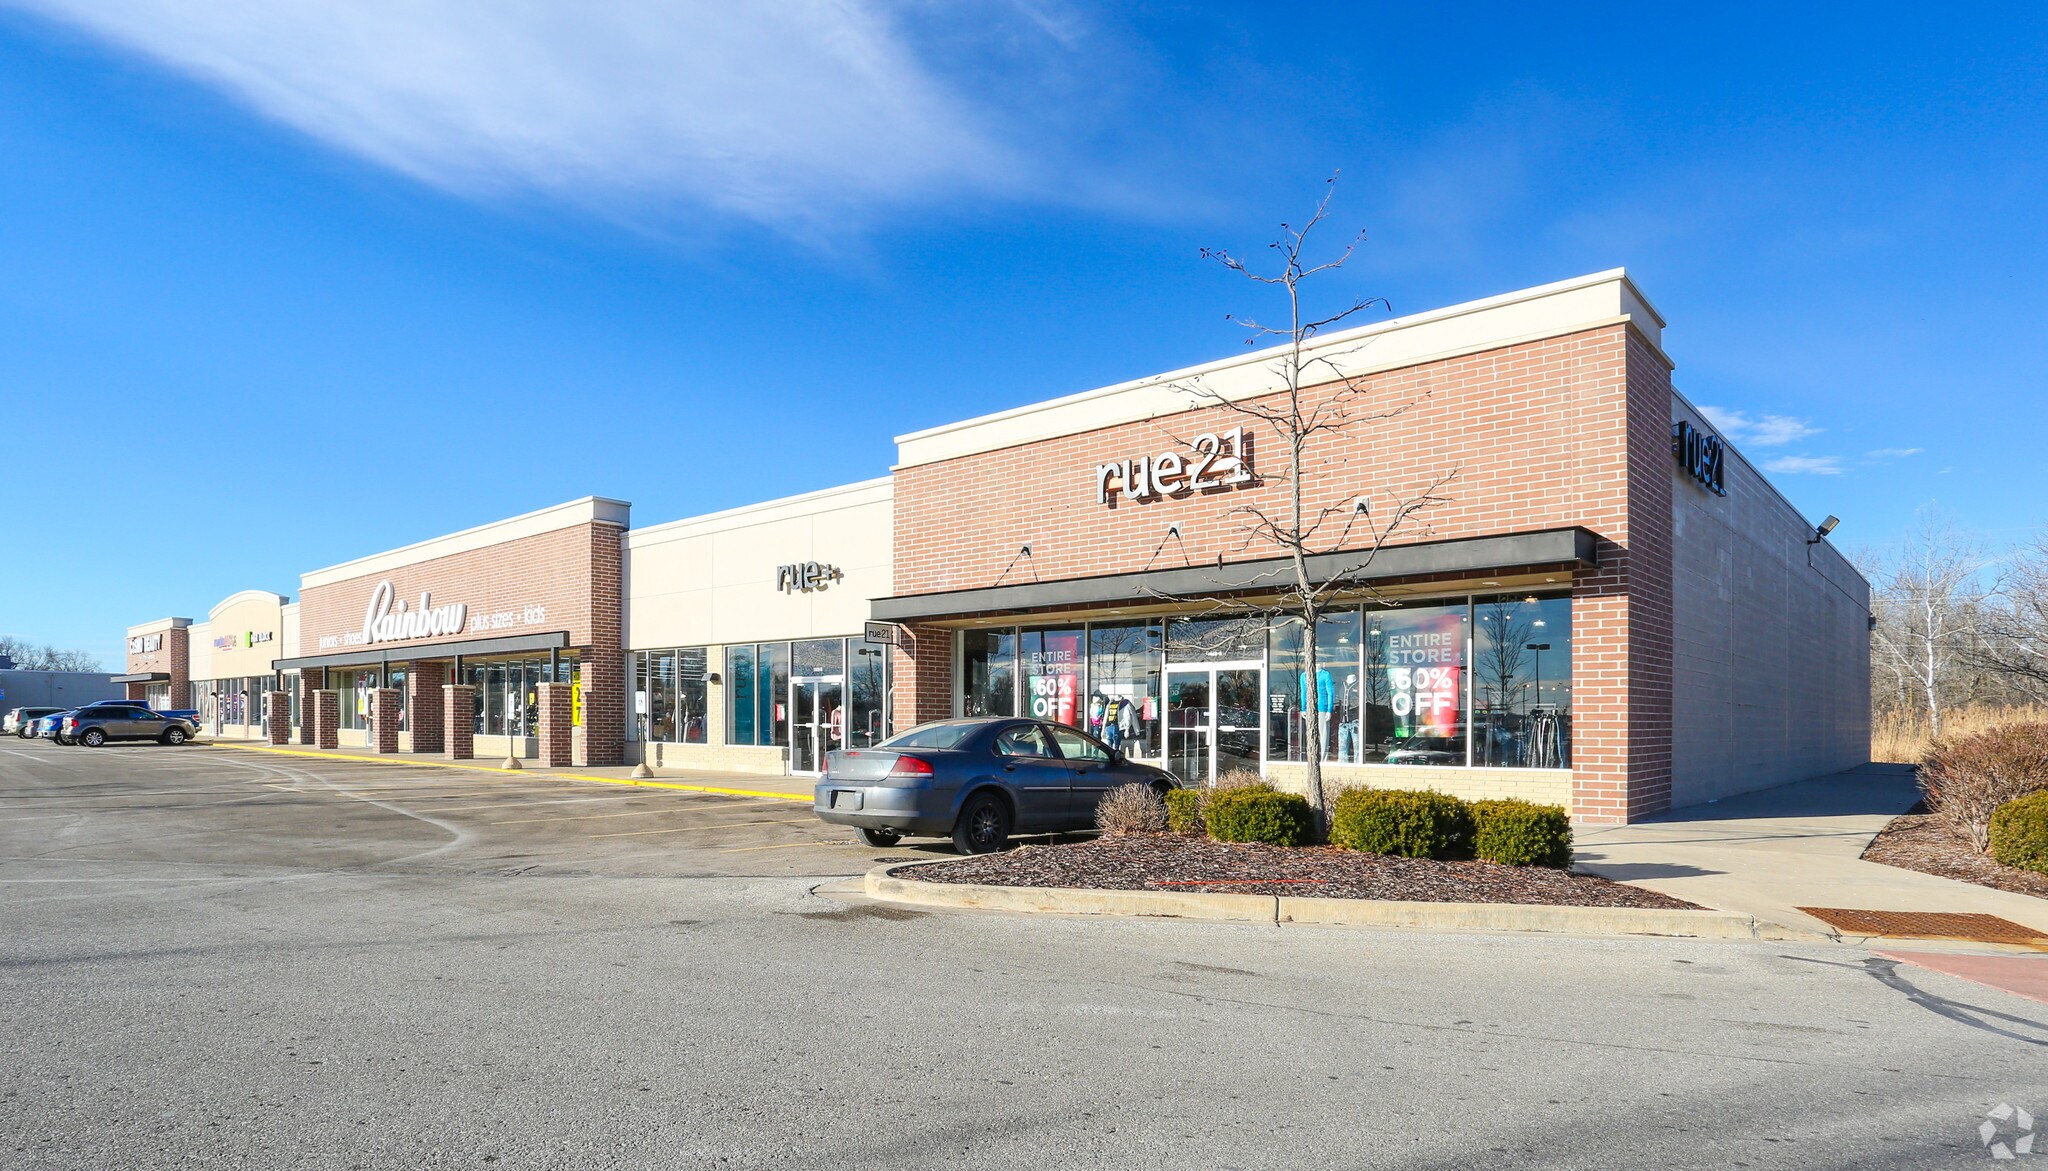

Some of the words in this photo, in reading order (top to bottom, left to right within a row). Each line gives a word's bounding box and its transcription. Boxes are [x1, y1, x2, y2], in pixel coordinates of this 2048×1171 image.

[1096, 426, 1251, 504] rue21
[1679, 420, 1727, 497] rue21
[363, 580, 467, 644] Rainbow
[524, 603, 545, 625] kids
[868, 629, 890, 639] rue21
[1389, 632, 1452, 648] ENTIRE
[1031, 650, 1071, 662] ENTIRE
[1389, 648, 1452, 664] STORE
[1033, 663, 1071, 675] STORE
[1037, 678, 1072, 696] 60%
[1033, 697, 1071, 717] OFF
[1392, 692, 1452, 716] OFF
